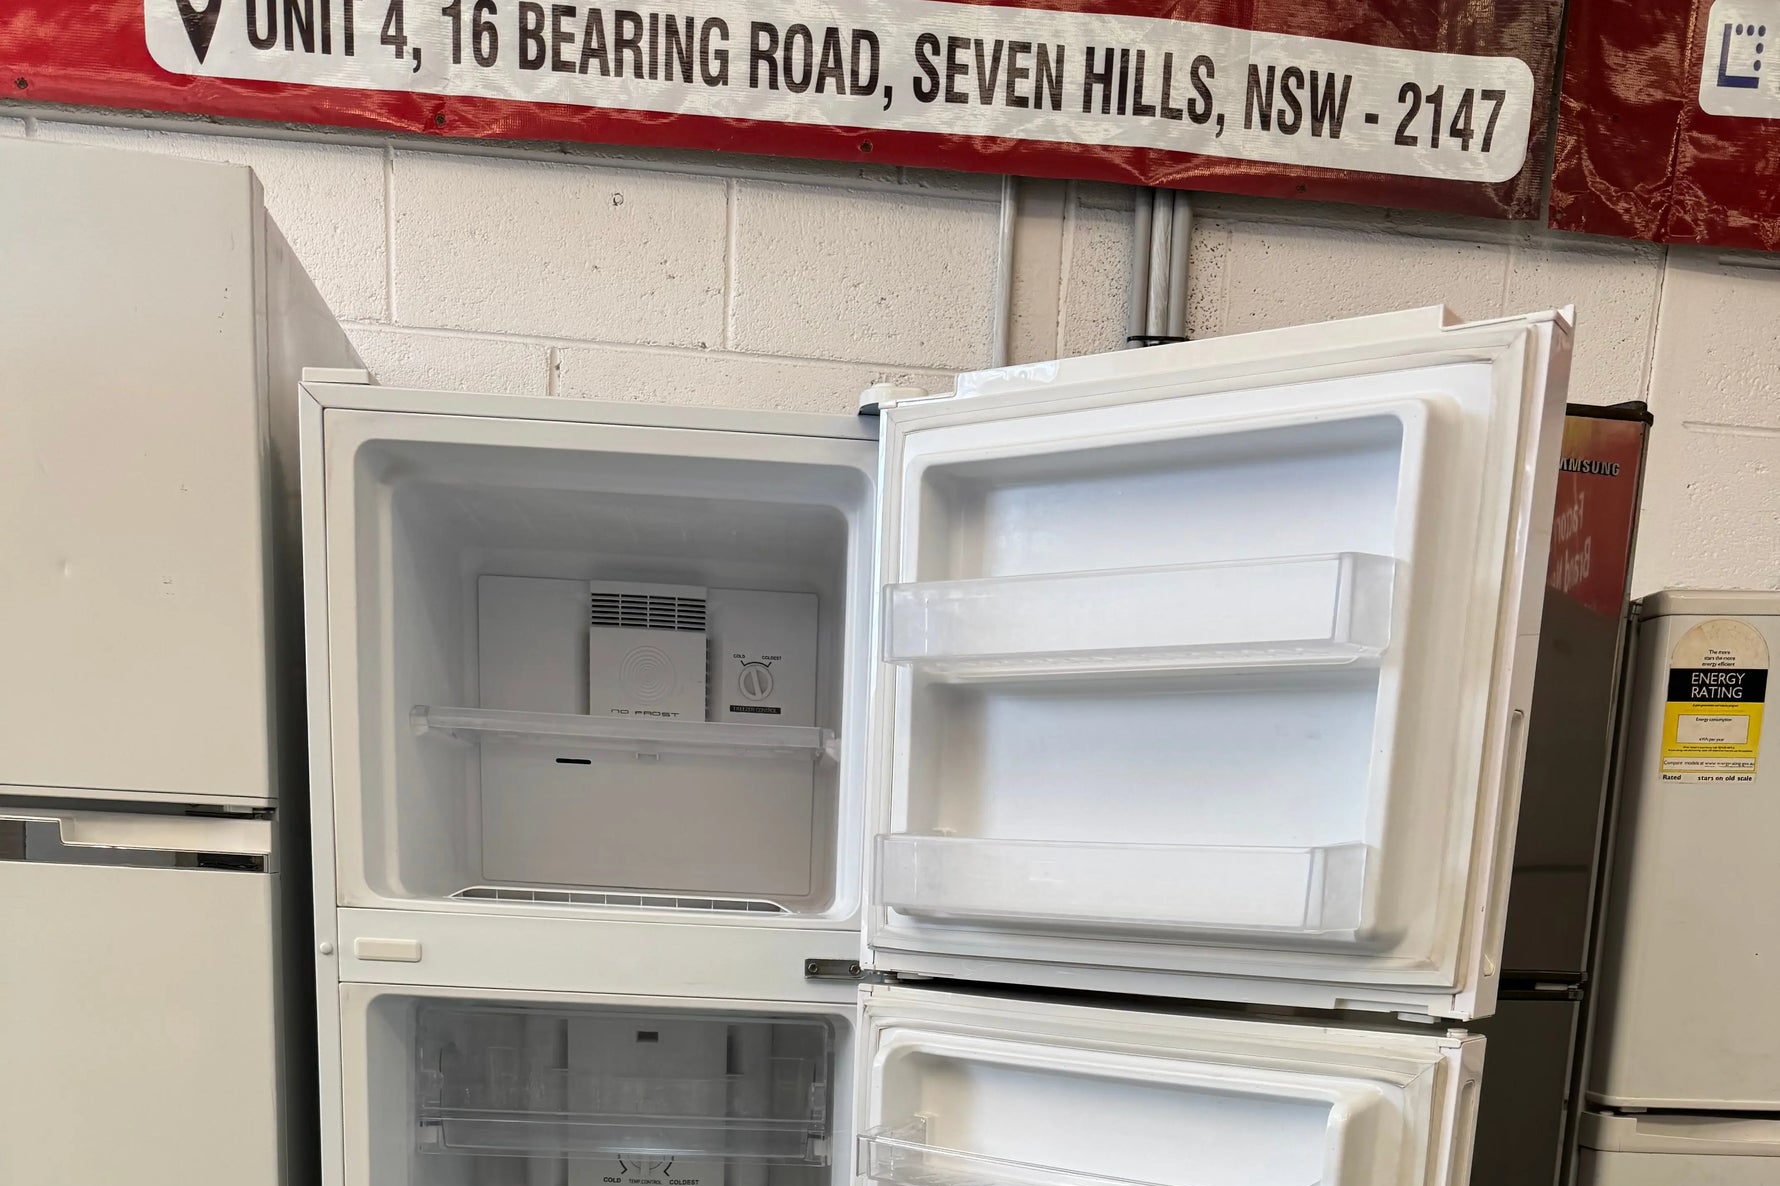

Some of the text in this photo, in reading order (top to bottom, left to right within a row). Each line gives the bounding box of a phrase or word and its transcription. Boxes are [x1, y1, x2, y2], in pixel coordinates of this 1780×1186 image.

[246, 0, 360, 57] UNIT
[380, 0, 421, 74] 4,
[442, 0, 498, 67] 16
[519, 1, 729, 87] BEARING
[750, 21, 893, 111] ROAD,
[913, 32, 1066, 111] SEVEN
[1082, 46, 1225, 138] HILLS,
[1244, 64, 1353, 140] NSW
[1394, 82, 1507, 152] 2147
[1560, 458, 1620, 476] AMSUNG
[1691, 672, 1746, 685] ENERGY
[1691, 686, 1743, 699] RATING
[634, 710, 680, 718] FROST
[603, 1176, 622, 1184] COLD
